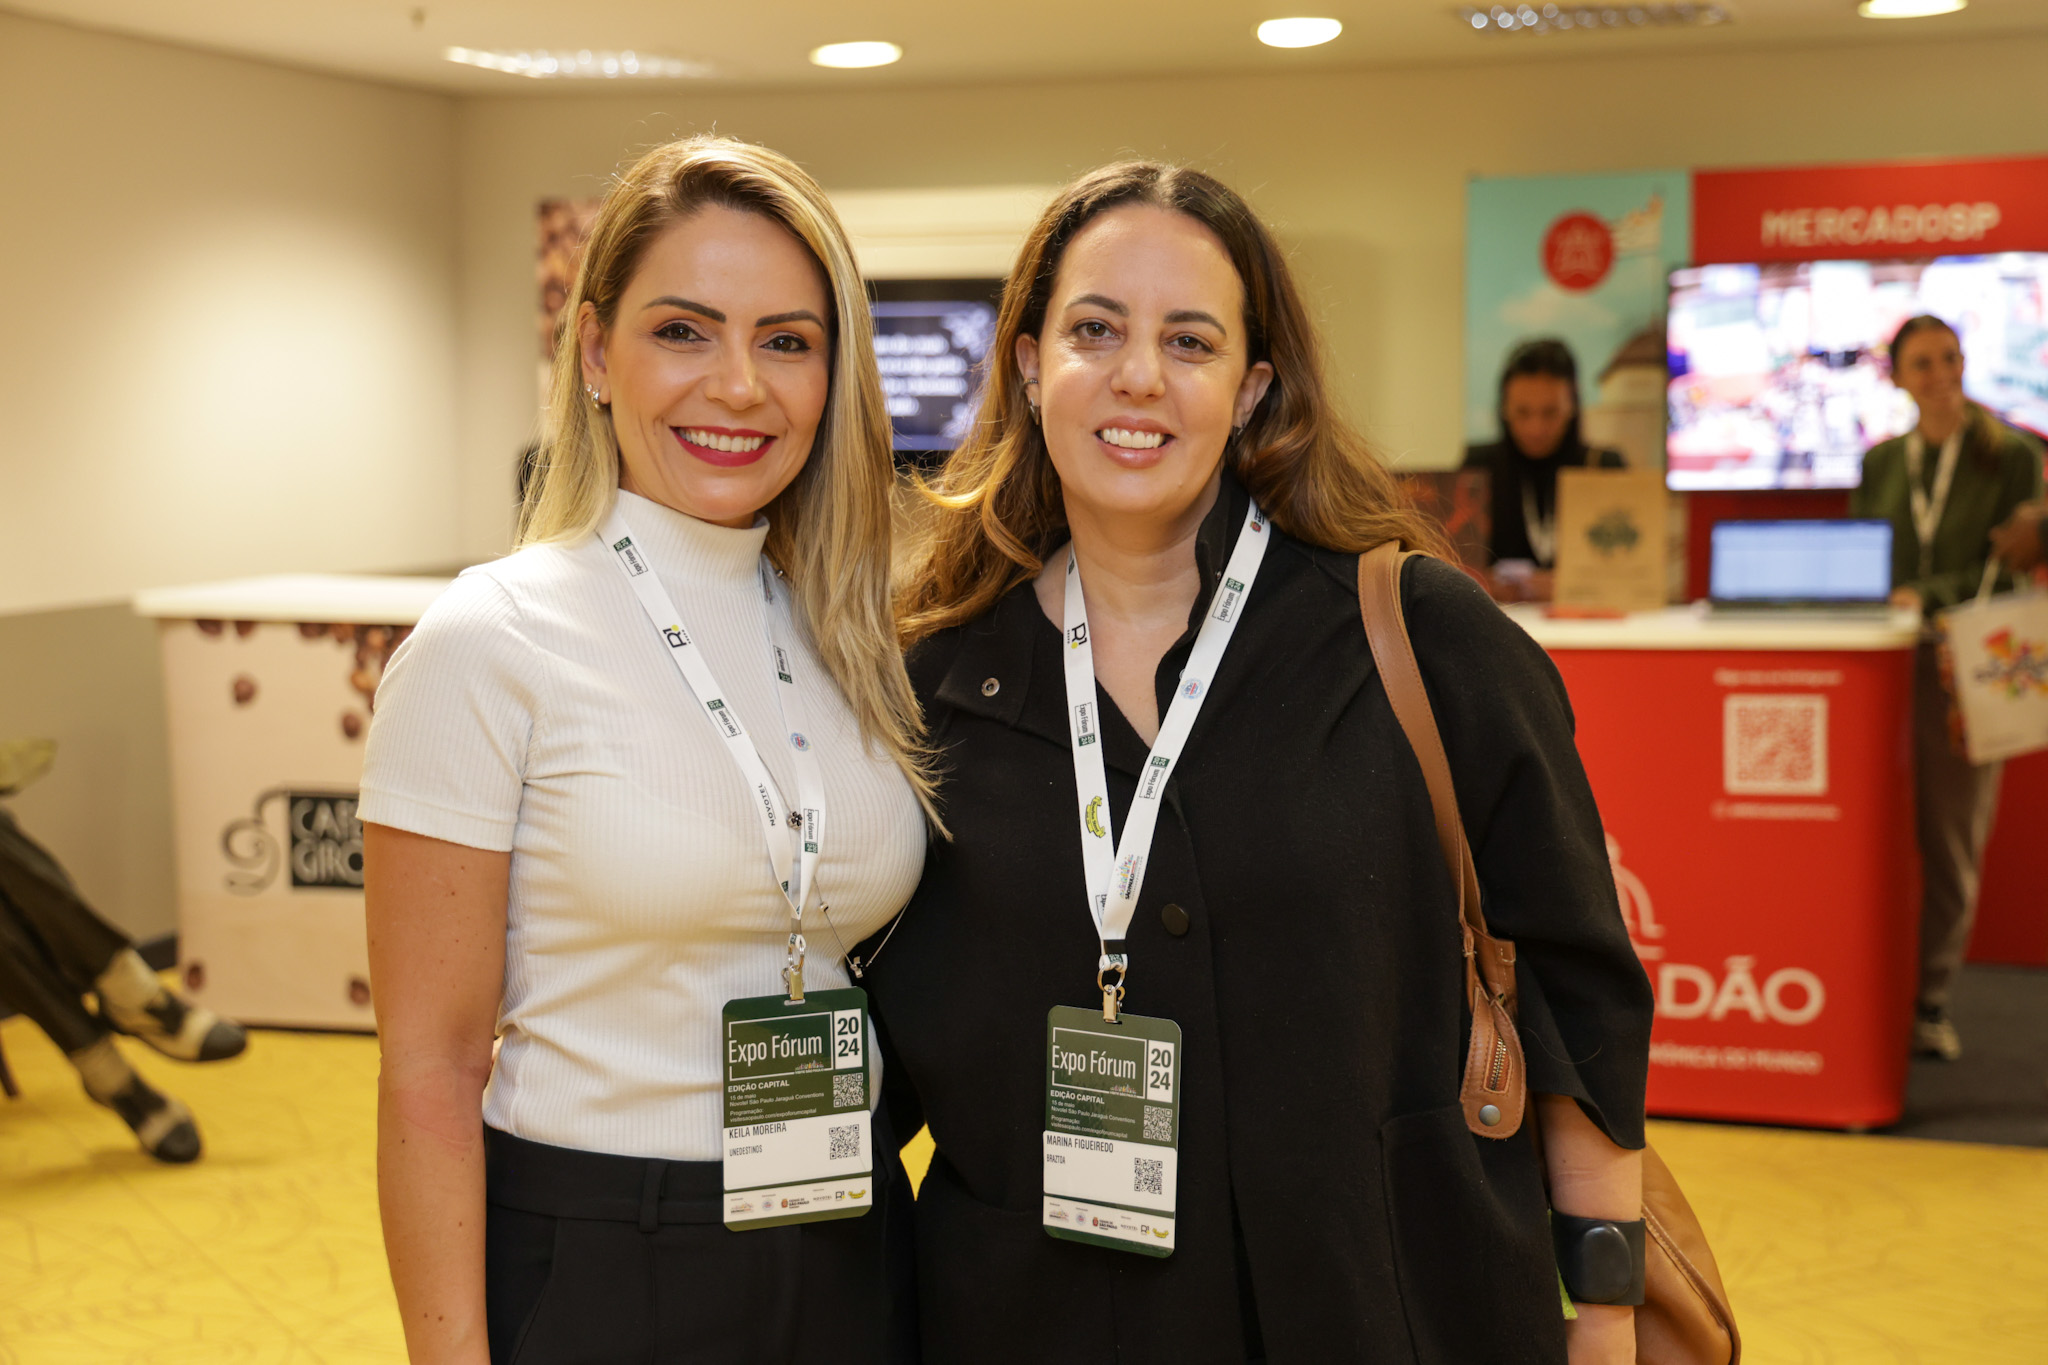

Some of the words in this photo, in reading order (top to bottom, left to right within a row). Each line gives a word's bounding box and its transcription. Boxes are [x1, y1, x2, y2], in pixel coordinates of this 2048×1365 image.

[1217, 607, 1228, 621] Expo
[1144, 786, 1153, 798] Expo
[758, 783, 775, 826] NOVOTEL
[837, 1017, 859, 1036] 20
[729, 1040, 767, 1067] Expo
[772, 1033, 822, 1059] Fórum
[838, 1038, 860, 1058] 24
[1052, 1045, 1086, 1076] Expo
[1090, 1050, 1136, 1079] Fórum
[1150, 1048, 1172, 1068] 20
[728, 1083, 757, 1092] EDIÇÃO
[758, 1080, 790, 1089] CAPITAL
[1150, 1071, 1171, 1090] 24
[795, 1092, 824, 1100] Conventions
[1050, 1090, 1076, 1100] EDIÇÃO
[1077, 1094, 1105, 1104] CAPITAL
[1109, 1114, 1135, 1123] Conventions
[729, 1127, 750, 1139] KEILA
[753, 1122, 787, 1136] MOREIRA
[1047, 1135, 1072, 1148] MARINA
[1075, 1138, 1114, 1153] FIGUEIREDO
